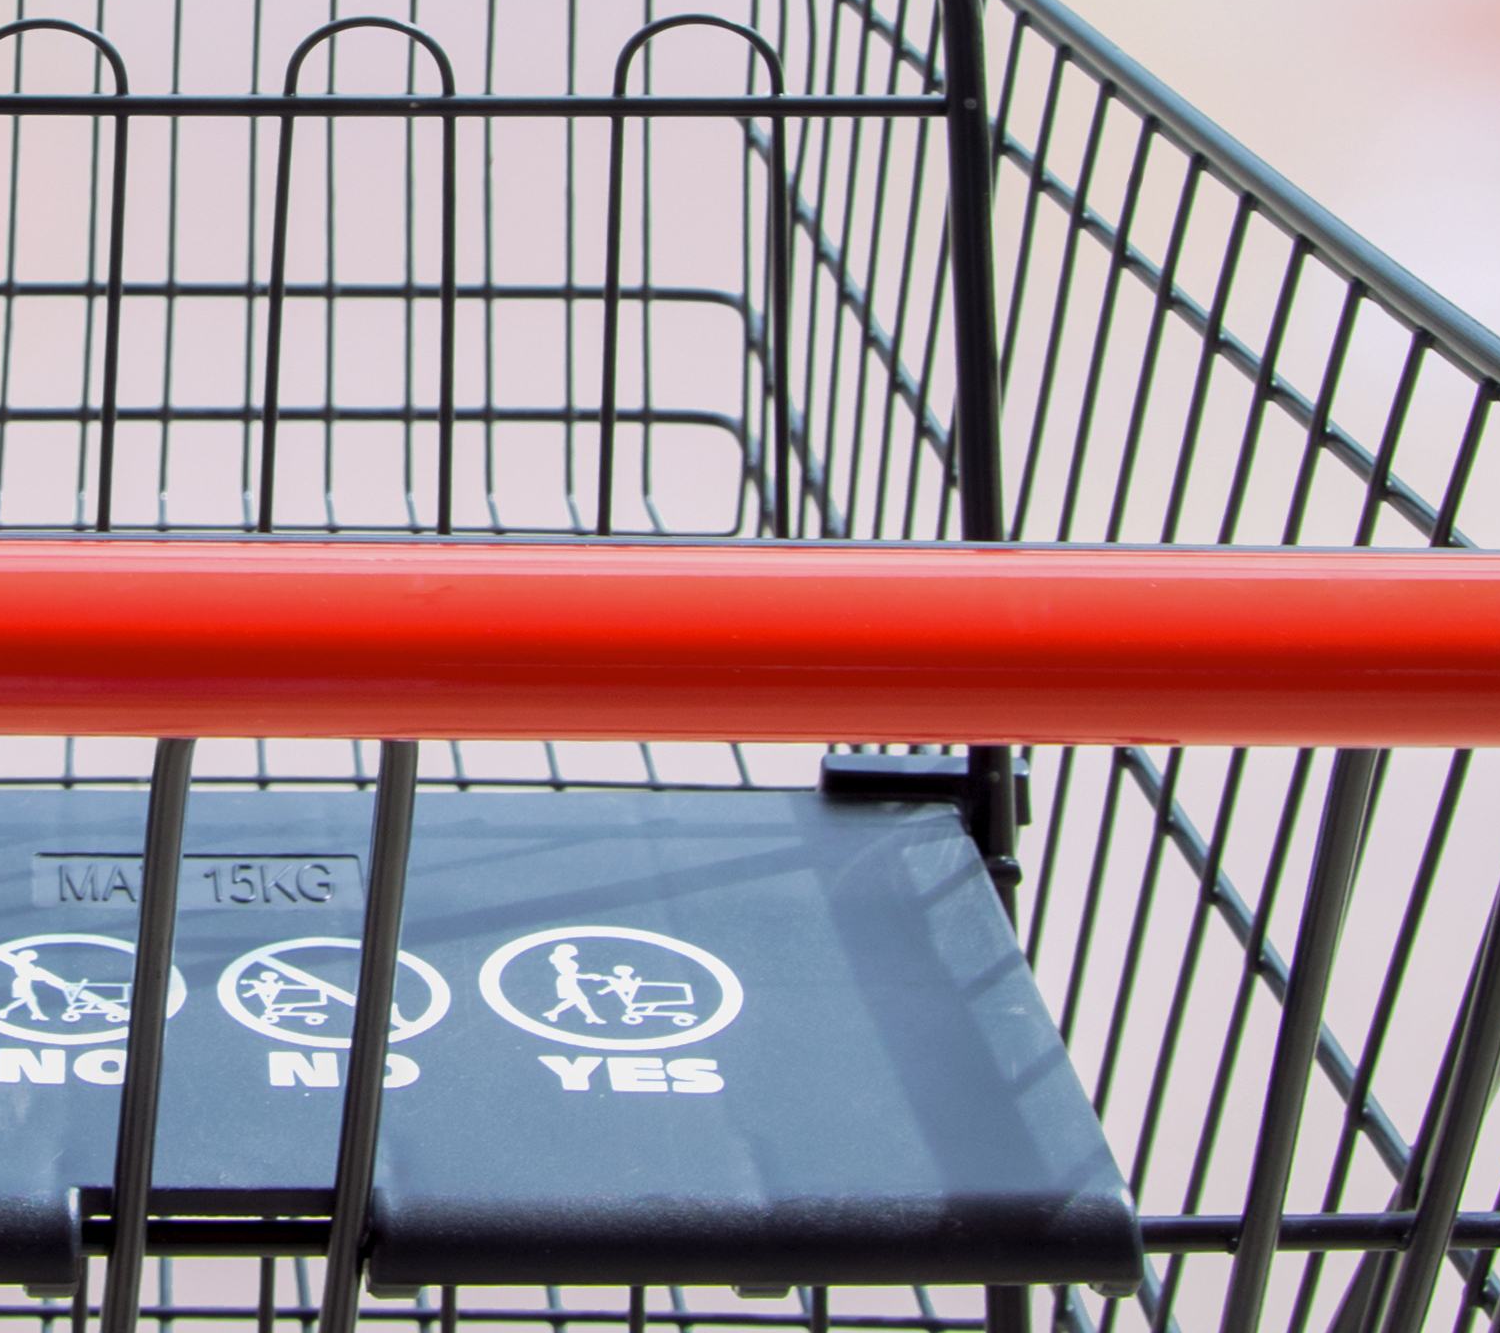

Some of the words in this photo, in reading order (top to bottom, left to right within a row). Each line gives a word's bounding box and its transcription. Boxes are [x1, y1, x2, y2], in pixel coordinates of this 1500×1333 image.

[58, 863, 148, 903] MA
[203, 863, 334, 904] 15KG
[537, 1055, 725, 1094] YES
